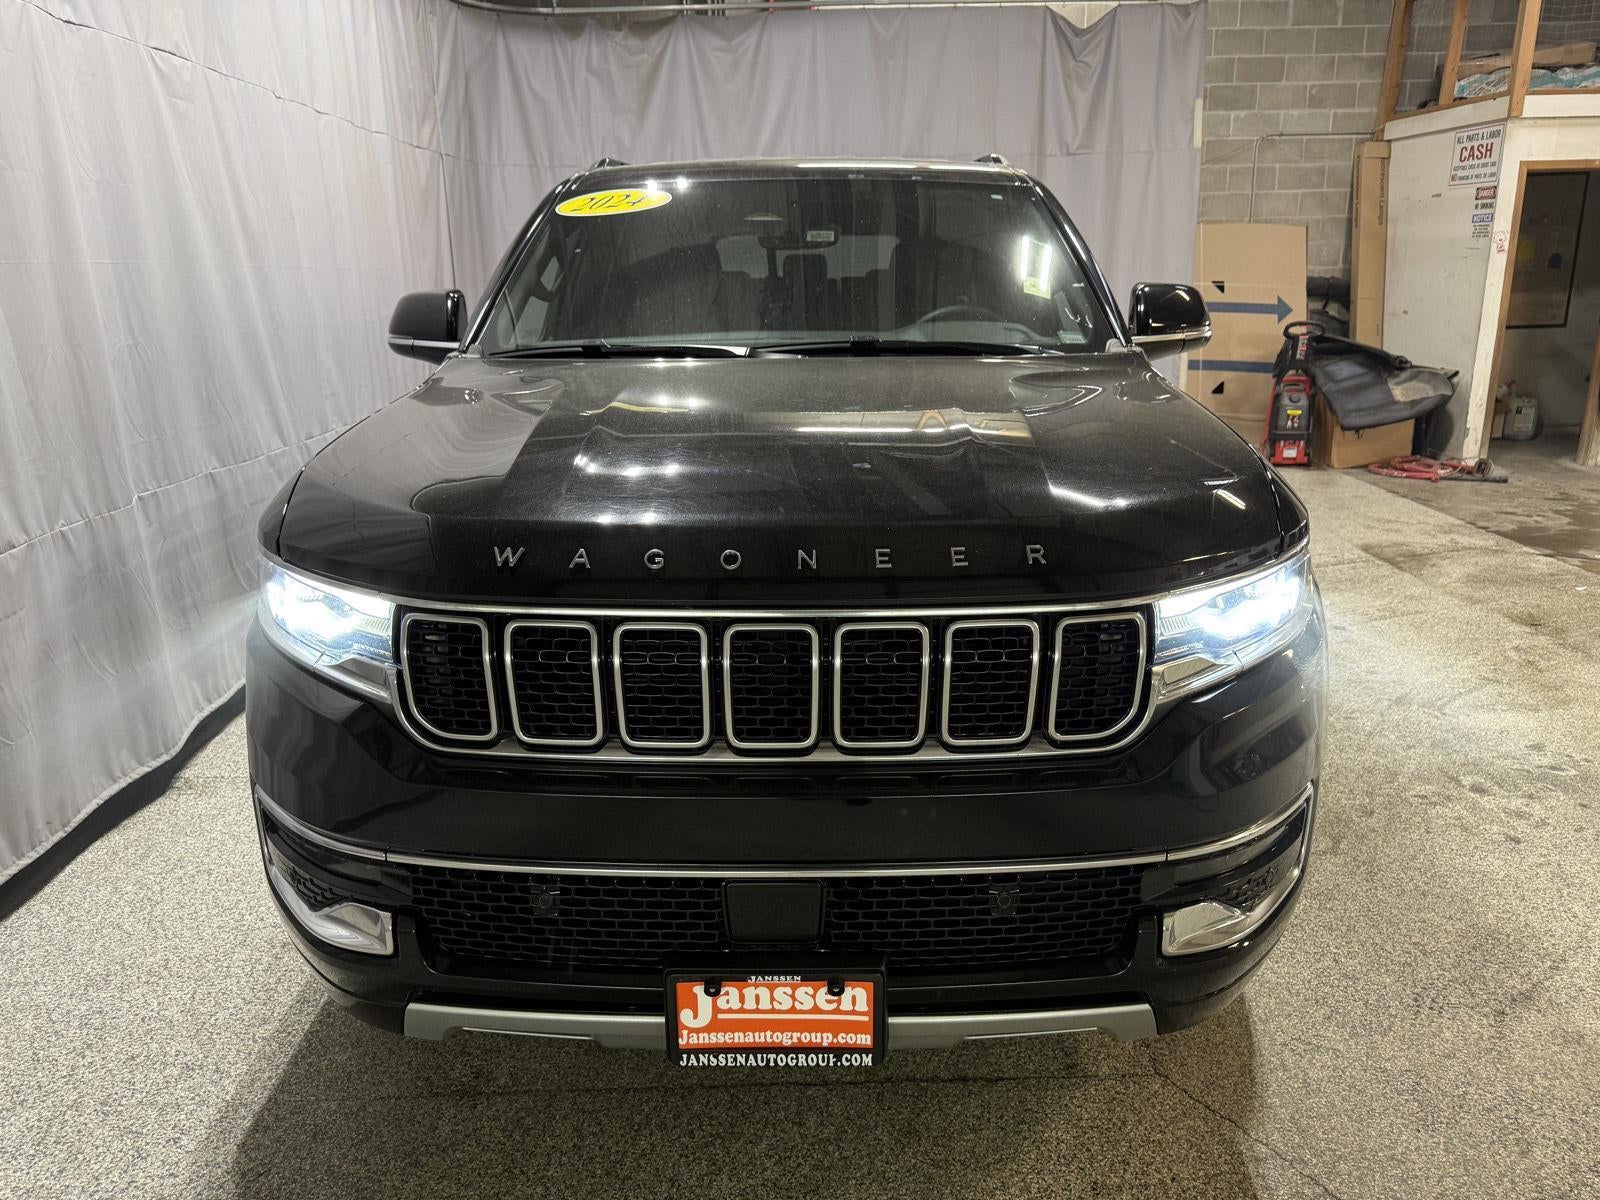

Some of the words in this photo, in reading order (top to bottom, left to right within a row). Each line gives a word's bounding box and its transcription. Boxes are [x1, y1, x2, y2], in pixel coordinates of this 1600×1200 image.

[1457, 135, 1465, 144] ALL
[1466, 132, 1480, 143] PARTS
[1486, 129, 1501, 139] LABOR
[1459, 142, 1494, 162] CASH
[568, 193, 650, 212] 2024
[1473, 214, 1492, 222] NOTICE
[493, 544, 1047, 570] WAGONEER
[748, 975, 802, 983] JANSSEN
[679, 985, 869, 1028] Janssen
[678, 1030, 871, 1046] Janssenautogroup.com
[679, 1053, 873, 1067] JANSSENAUTOGROUP.COM
